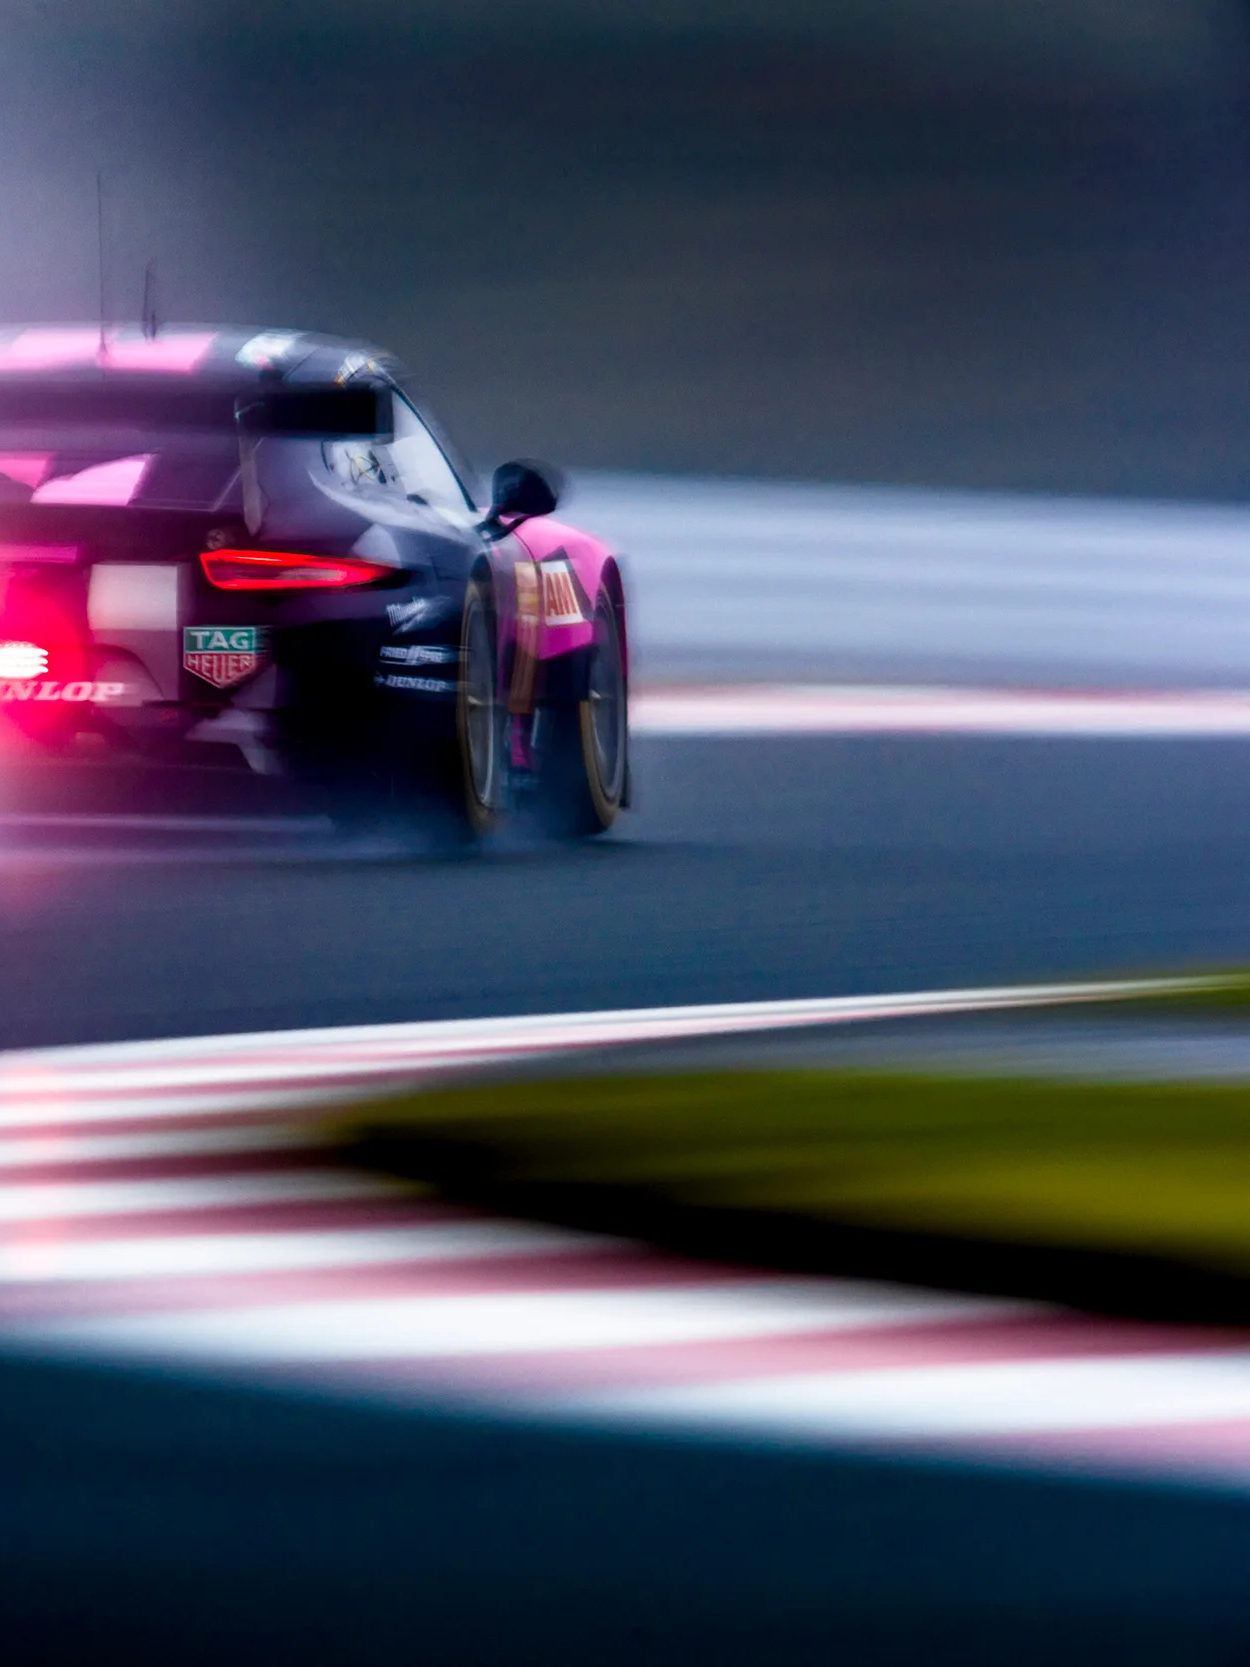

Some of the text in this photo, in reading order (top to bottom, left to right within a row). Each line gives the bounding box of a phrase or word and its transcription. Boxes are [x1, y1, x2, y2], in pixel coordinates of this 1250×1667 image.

[546, 572, 577, 616] AM
[190, 631, 249, 649] TAG
[188, 655, 251, 682] HEUER
[385, 675, 447, 692] DUNLOP
